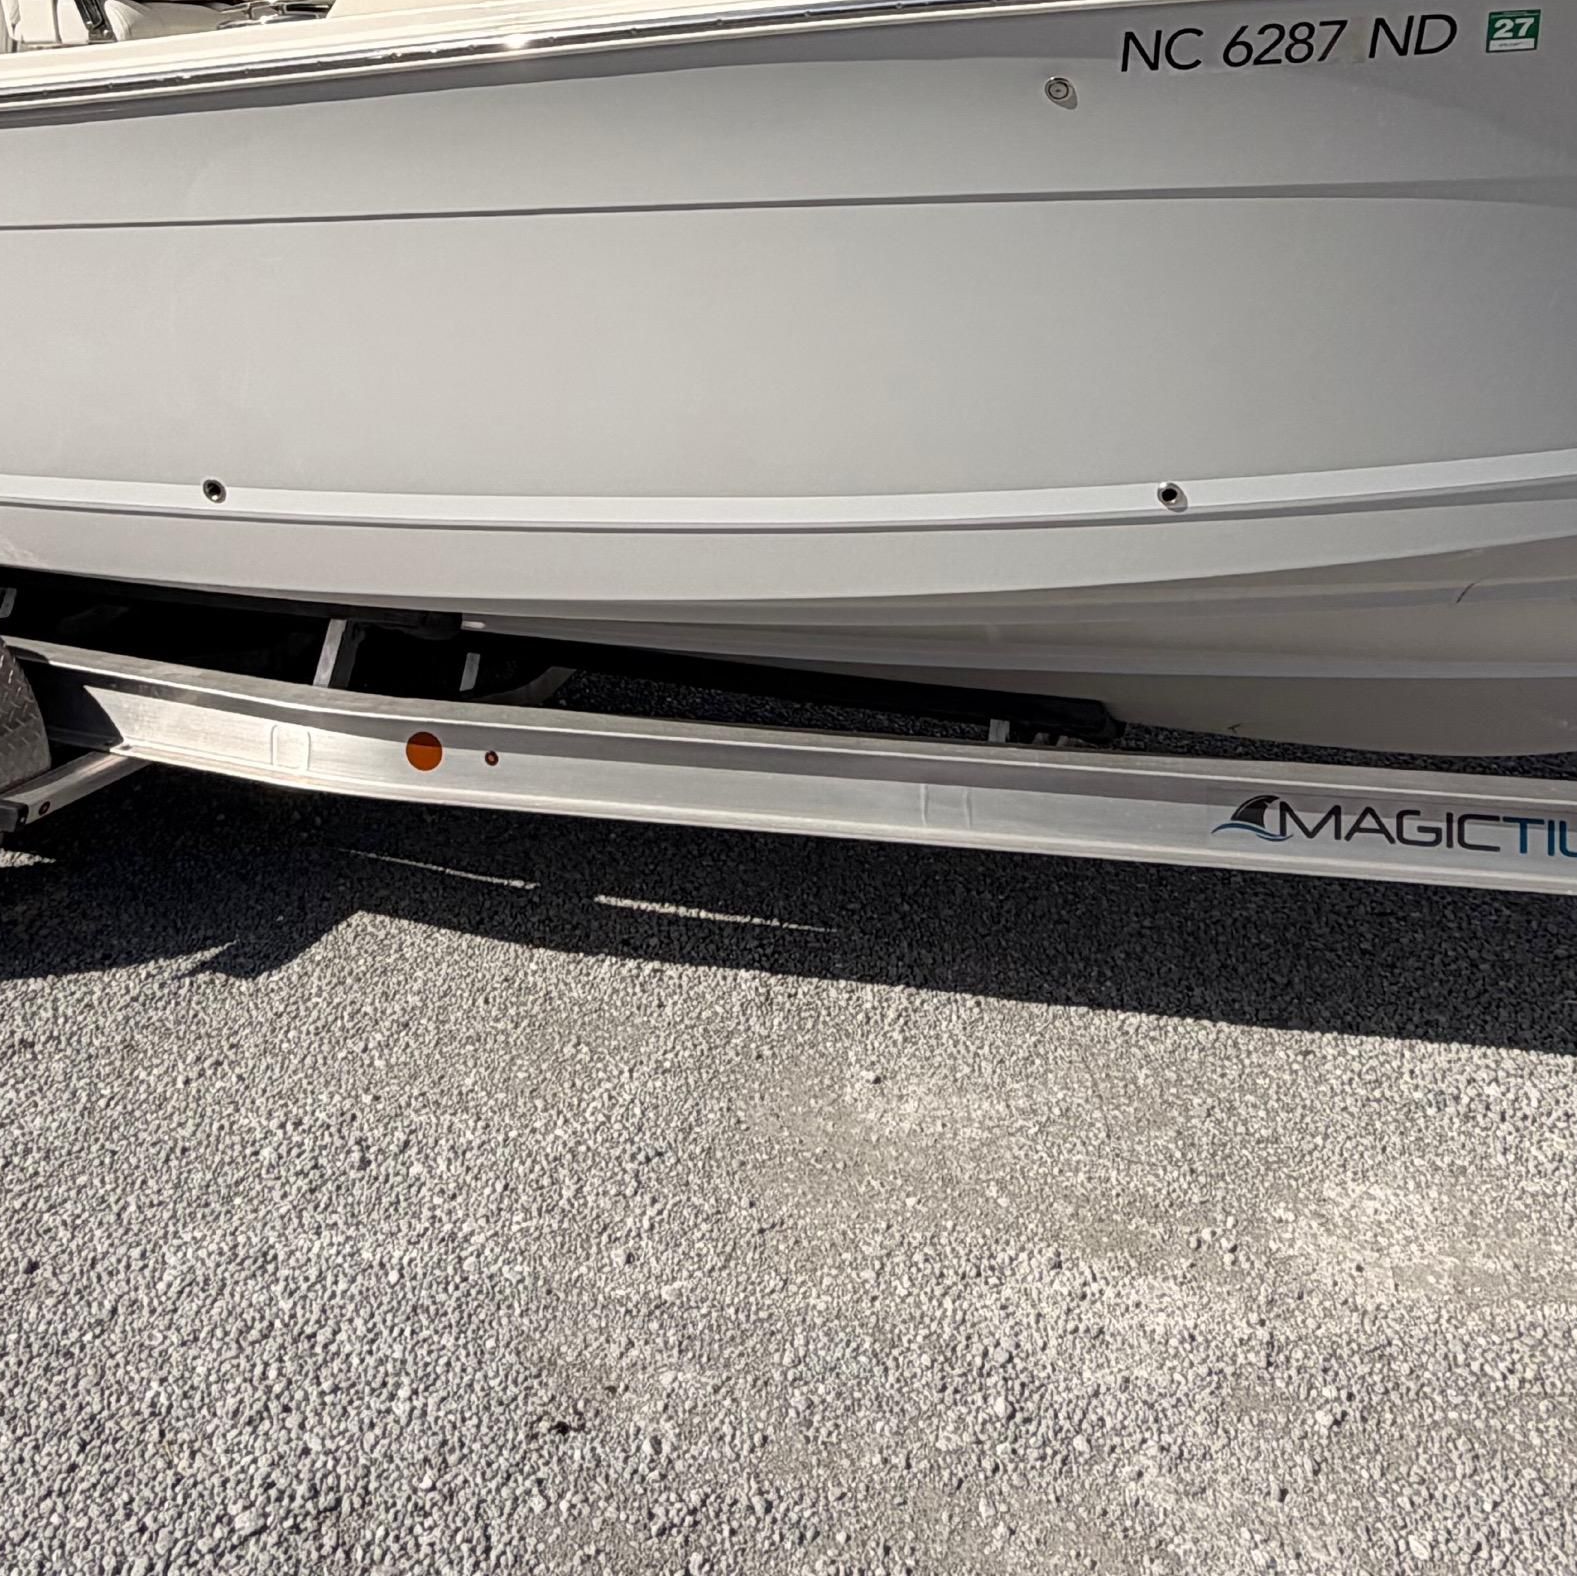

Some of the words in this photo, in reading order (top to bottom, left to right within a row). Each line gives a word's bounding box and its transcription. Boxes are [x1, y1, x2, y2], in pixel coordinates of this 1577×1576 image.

[1121, 28, 1204, 72] NC
[1222, 20, 1348, 67] 6287
[1368, 14, 1457, 58] ND
[1493, 17, 1535, 39] 27
